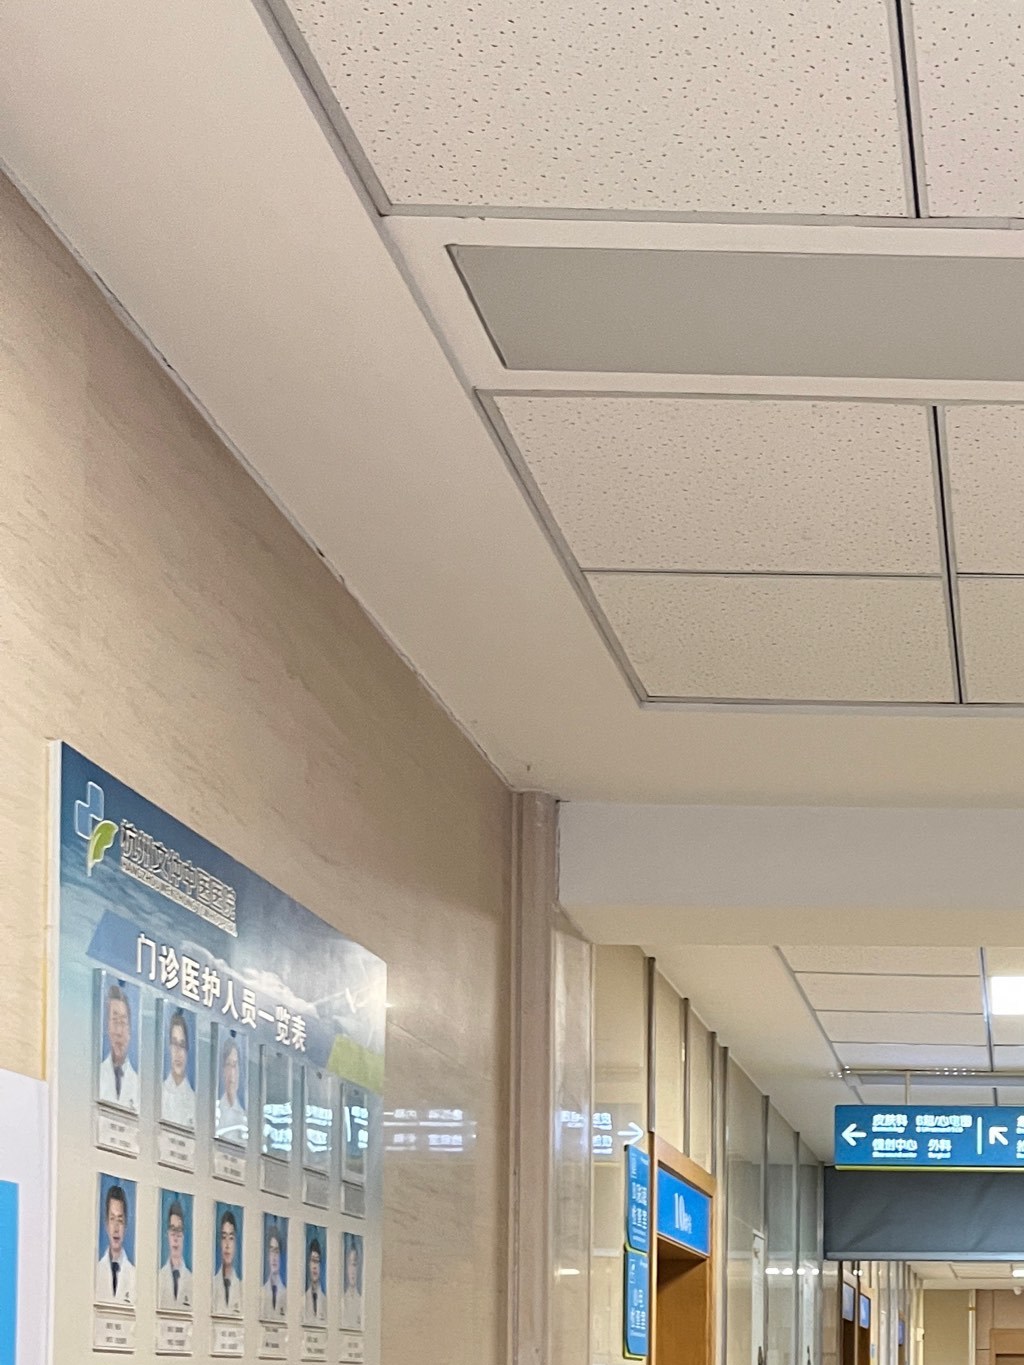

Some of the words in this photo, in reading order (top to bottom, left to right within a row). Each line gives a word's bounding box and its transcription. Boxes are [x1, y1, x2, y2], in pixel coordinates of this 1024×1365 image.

[136, 933, 306, 1052] 门诊医护人员一览表
[927, 1138, 952, 1151] 外科
